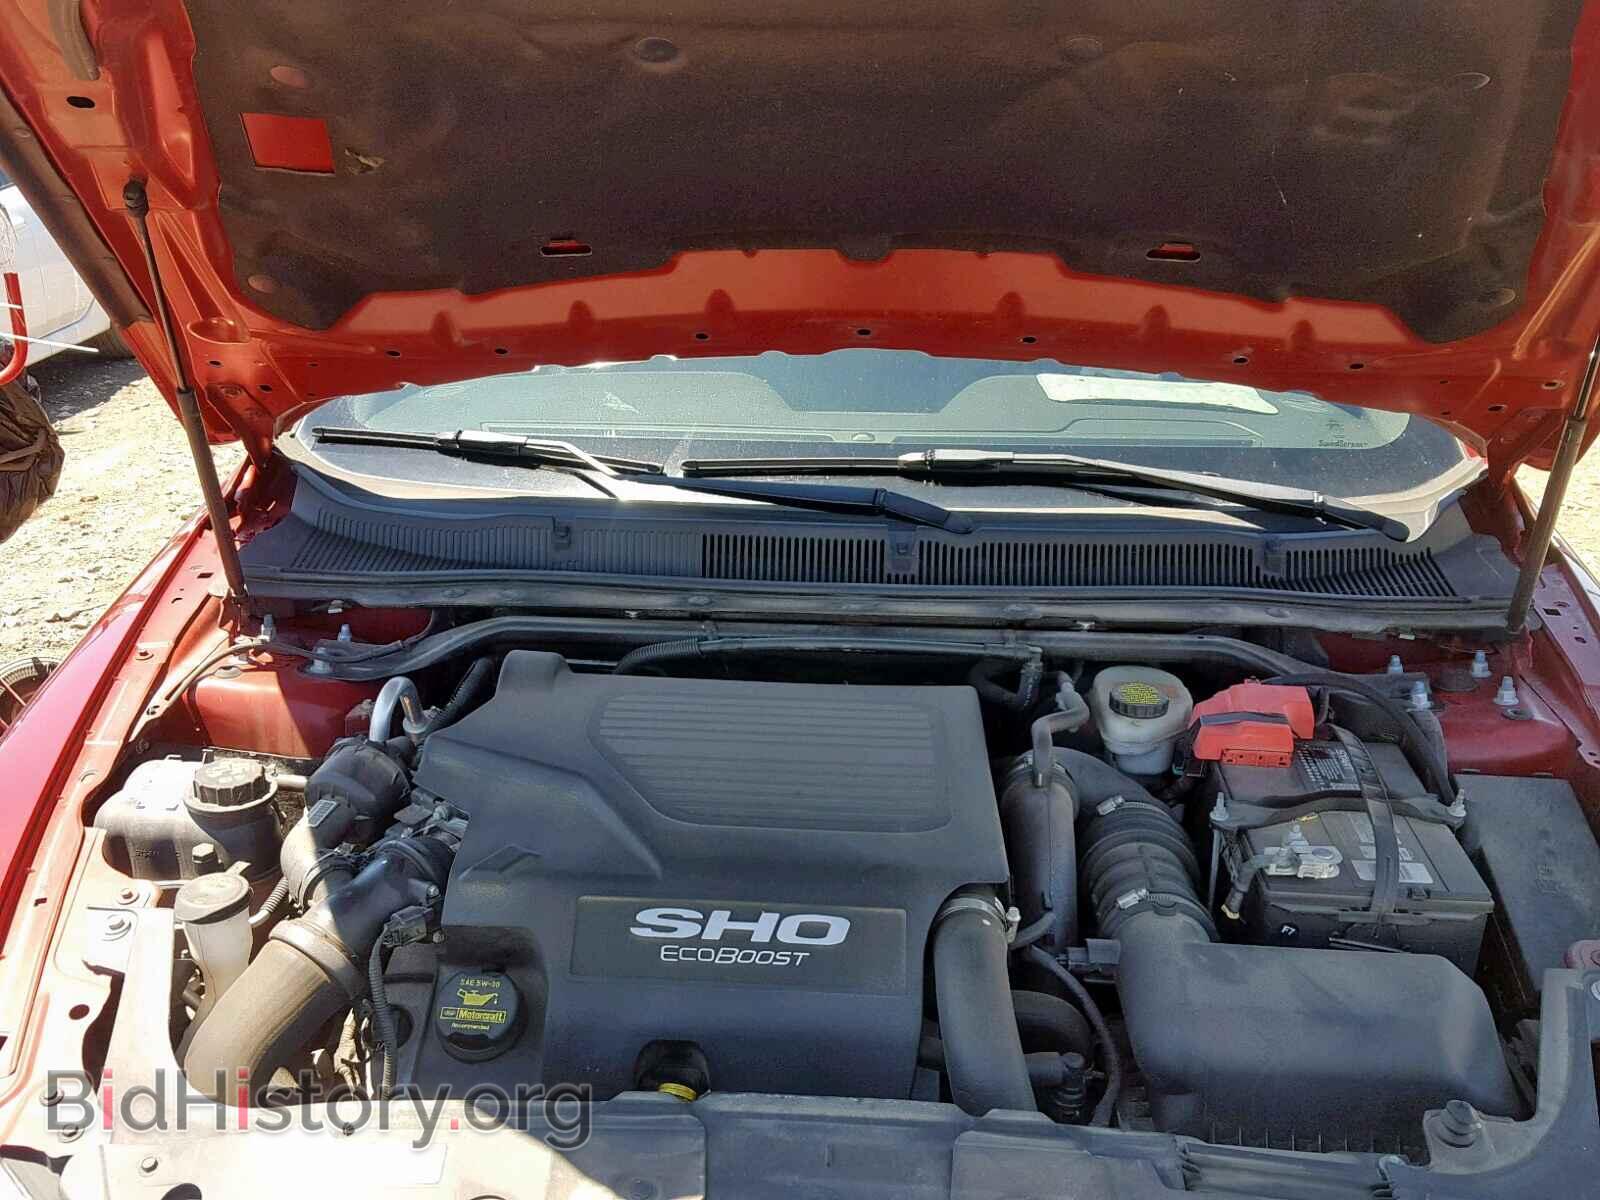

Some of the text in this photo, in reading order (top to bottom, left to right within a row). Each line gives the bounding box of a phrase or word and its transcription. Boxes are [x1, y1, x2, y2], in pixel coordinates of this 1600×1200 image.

[630, 907, 851, 946] SHO
[1281, 925, 1296, 936] F7
[459, 1009, 503, 1021] Motorcraft
